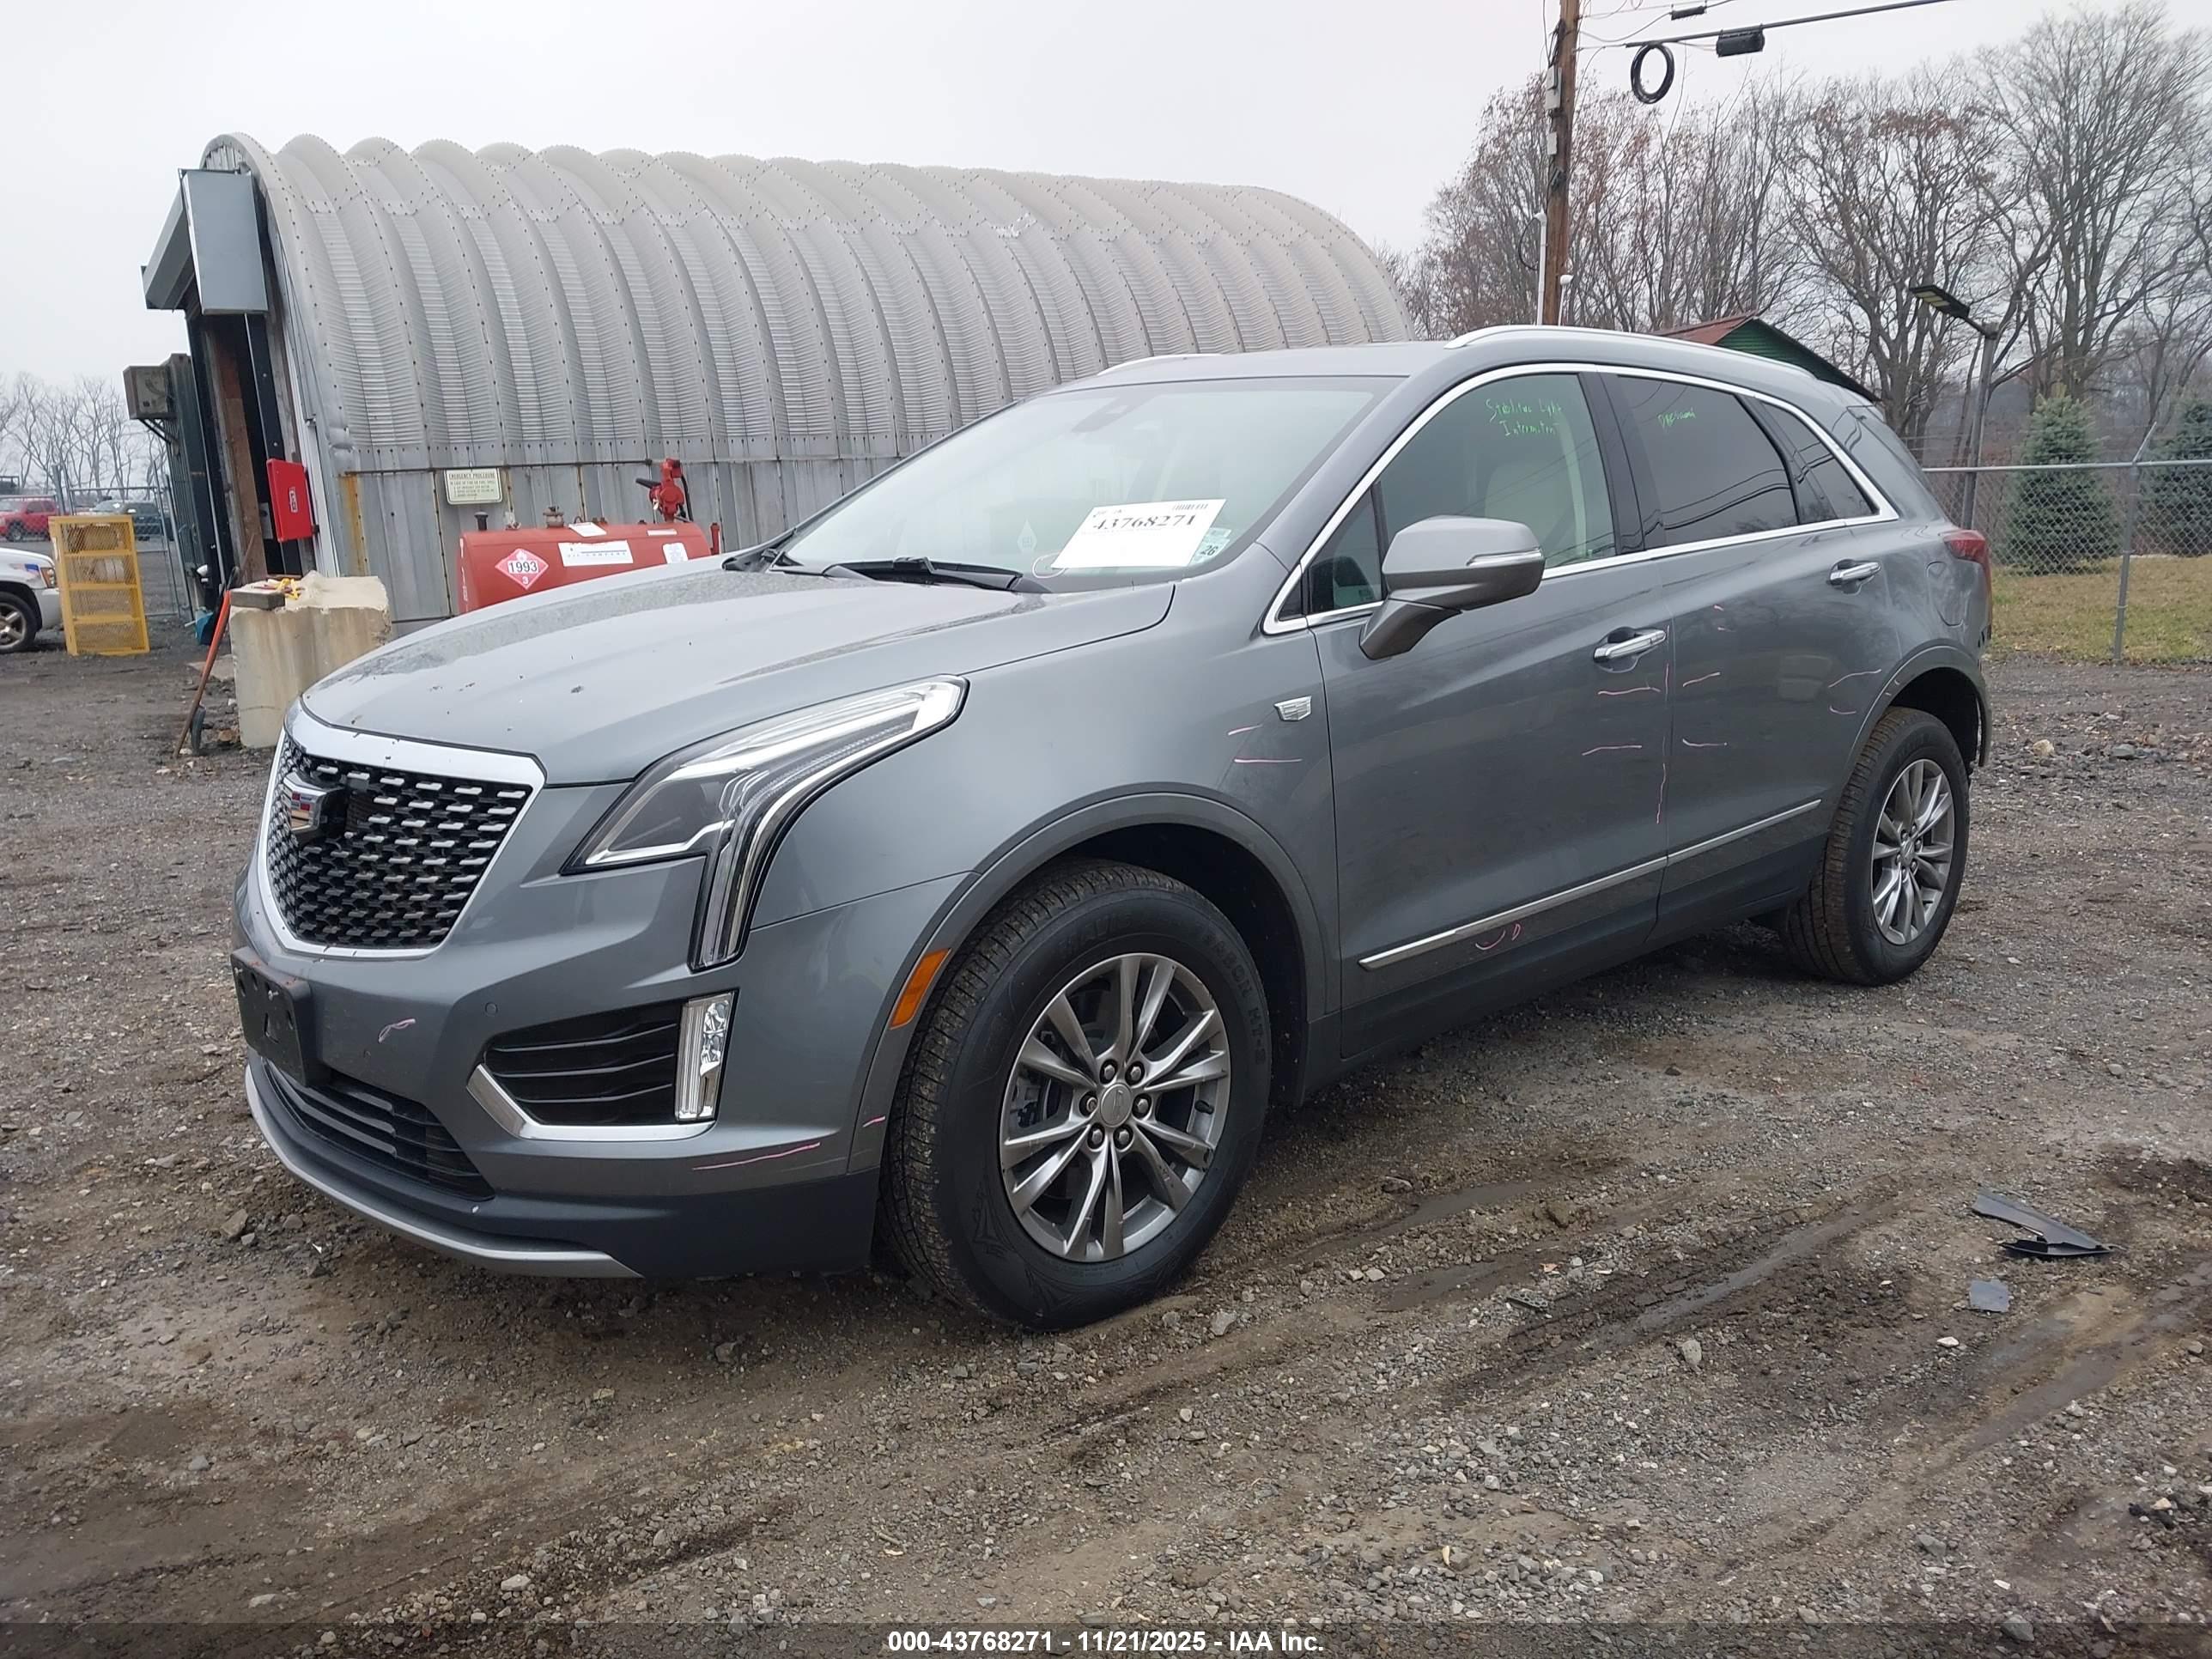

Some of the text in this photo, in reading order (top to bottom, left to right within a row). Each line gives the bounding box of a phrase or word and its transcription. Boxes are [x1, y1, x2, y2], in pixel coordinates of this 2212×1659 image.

[1092, 514, 1196, 530] 43768271
[509, 561, 538, 573] 1993
[522, 575, 529, 585] 3
